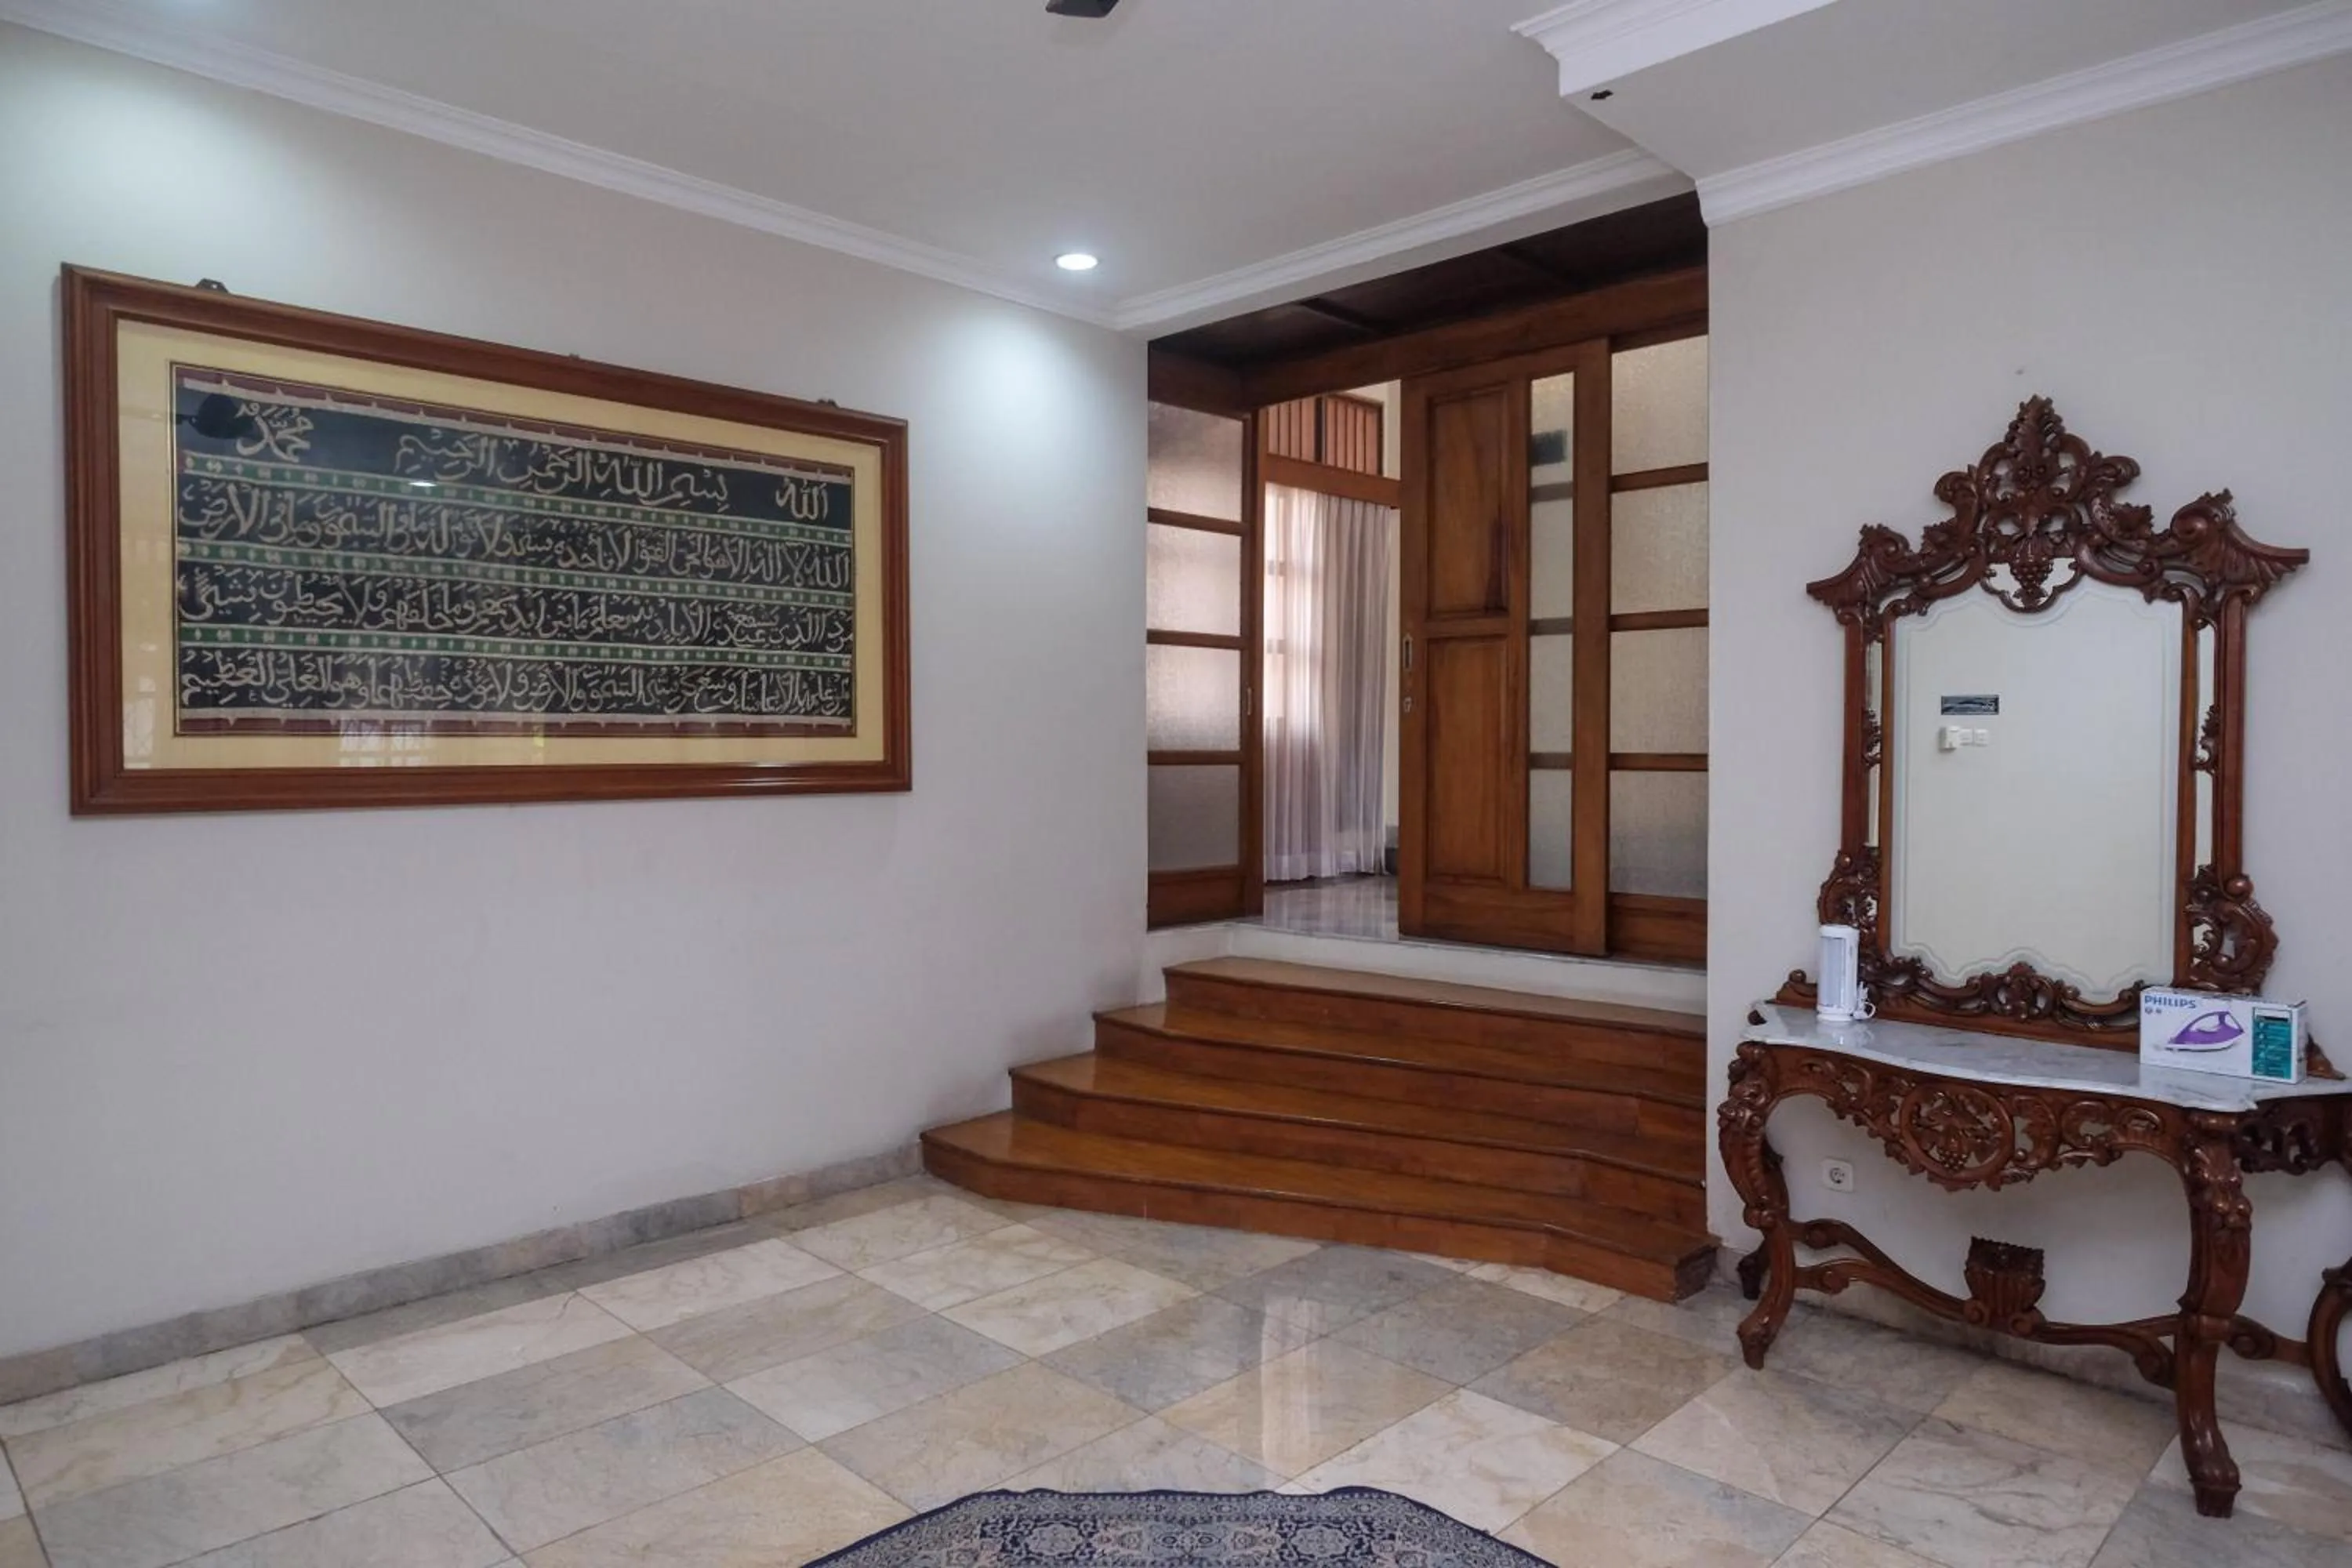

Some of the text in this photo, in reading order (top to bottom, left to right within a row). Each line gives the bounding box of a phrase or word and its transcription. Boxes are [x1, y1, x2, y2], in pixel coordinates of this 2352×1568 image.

[593, 451, 663, 499] الله
[775, 477, 829, 520] الله
[2144, 995, 2197, 1009] PHILIPS
